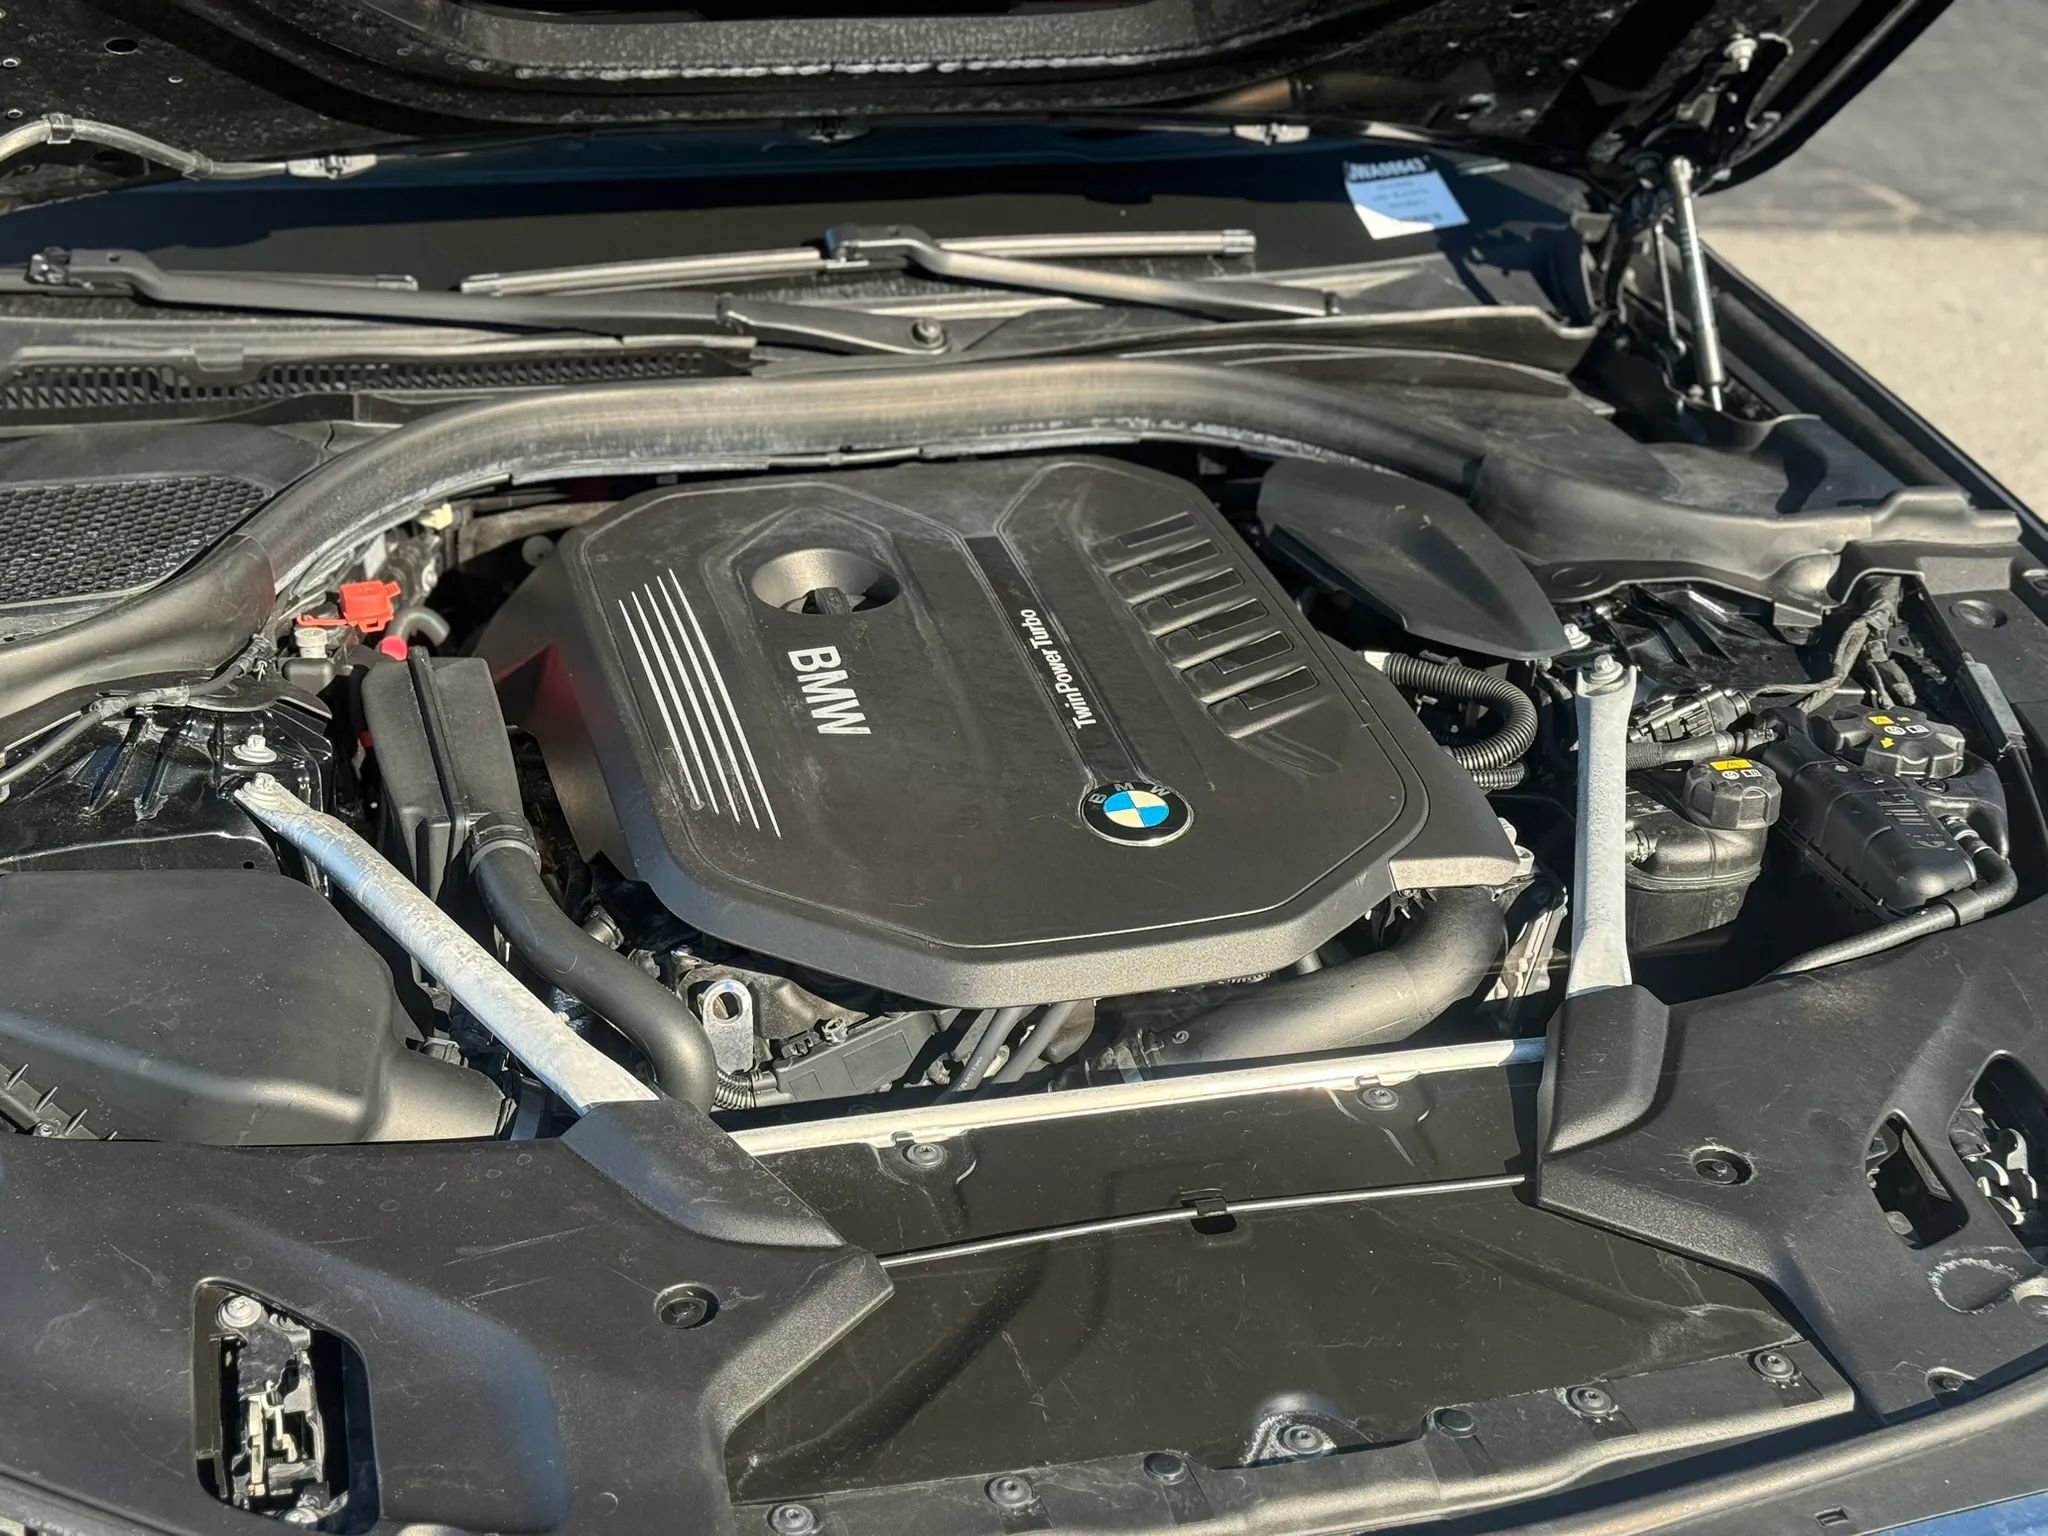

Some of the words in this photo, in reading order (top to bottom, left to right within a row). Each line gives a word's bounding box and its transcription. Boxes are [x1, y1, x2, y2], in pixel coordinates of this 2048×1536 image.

[1020, 609, 1053, 649] Turbo
[788, 646, 872, 734] BMW
[1041, 648, 1097, 729] TwinPower
[1088, 782, 1171, 804] BMW
